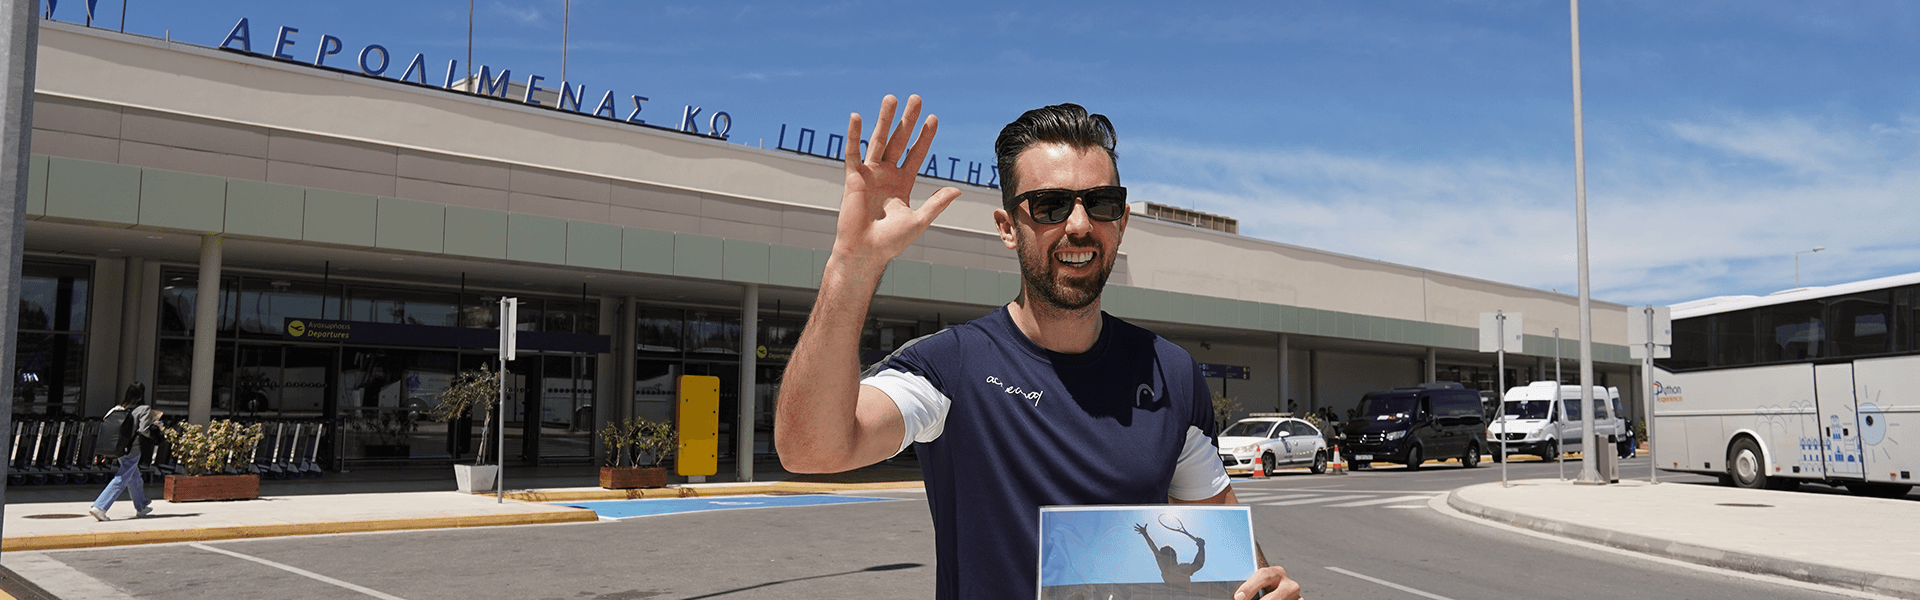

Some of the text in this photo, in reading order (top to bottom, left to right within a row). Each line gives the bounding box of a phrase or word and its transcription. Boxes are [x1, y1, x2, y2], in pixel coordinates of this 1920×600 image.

[218, 16, 649, 125] ΑΕΡΟΛΙΜΕΝΑΣ
[680, 104, 732, 138] ΚΩ
[308, 330, 349, 339] Departures
